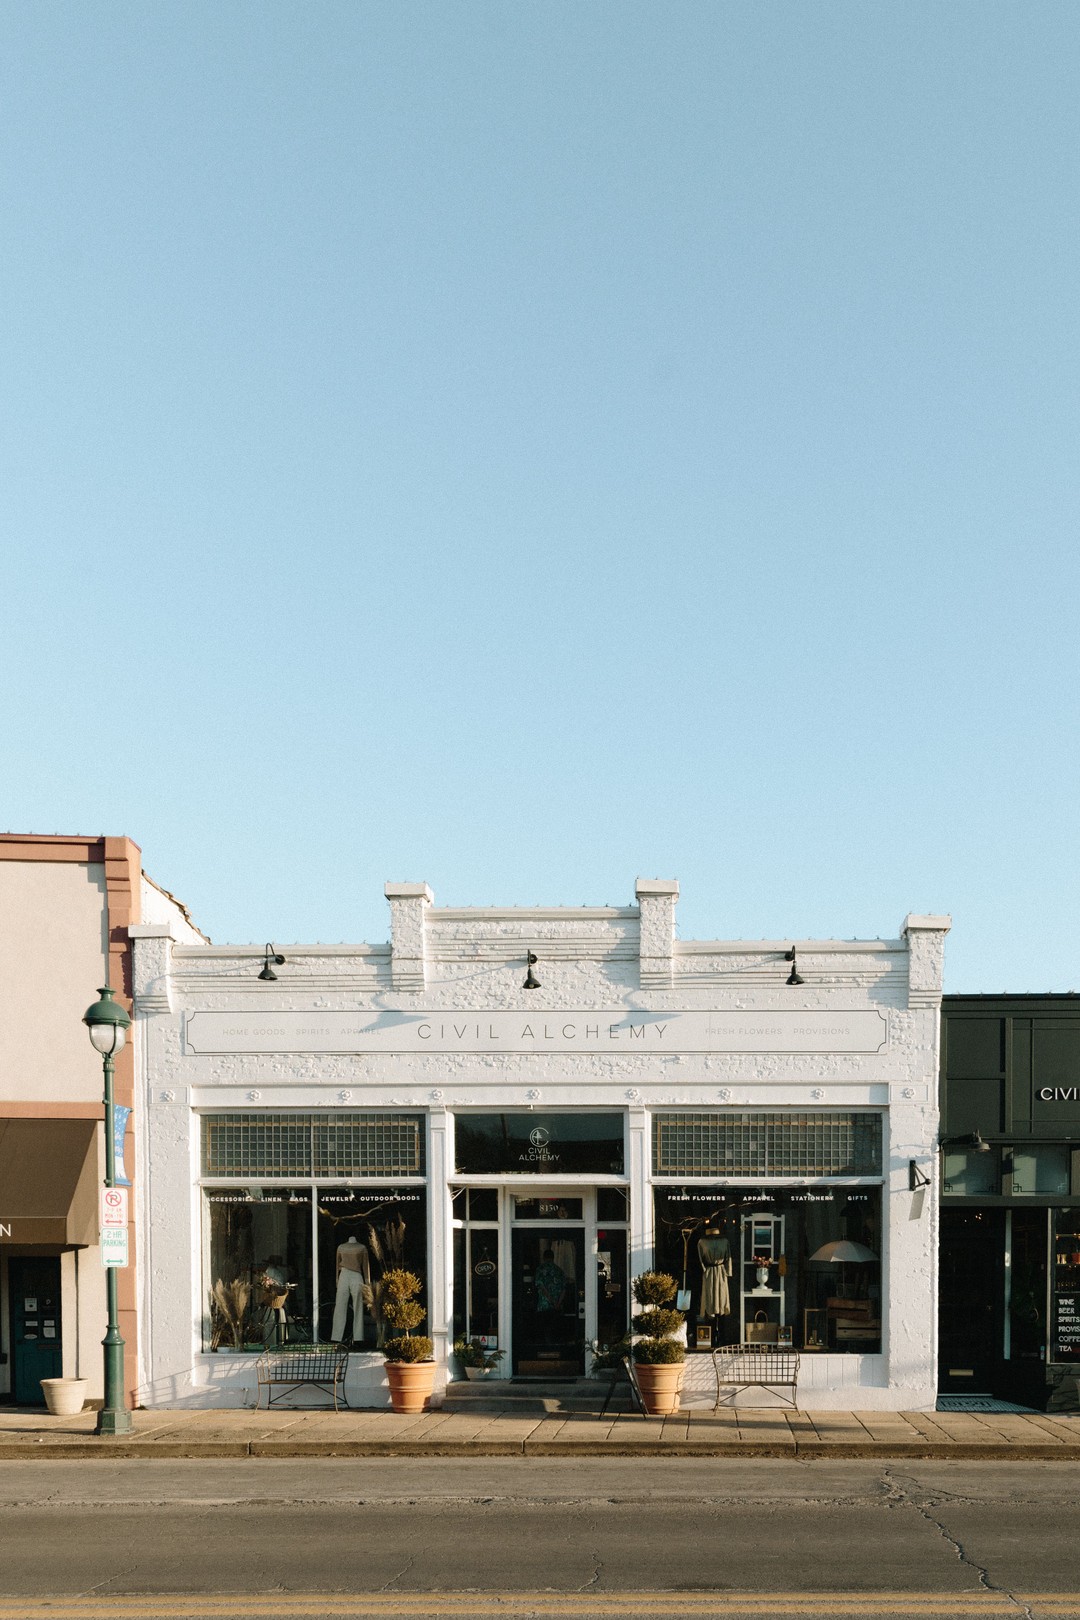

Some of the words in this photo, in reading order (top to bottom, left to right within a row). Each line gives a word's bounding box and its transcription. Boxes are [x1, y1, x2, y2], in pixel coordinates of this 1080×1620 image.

[222, 1028, 249, 1036] HOME
[252, 1028, 285, 1036] GOODS
[417, 1024, 499, 1039] CIVIL
[521, 1024, 667, 1039] ALCHEMY
[103, 1239, 126, 1247] PARKING
